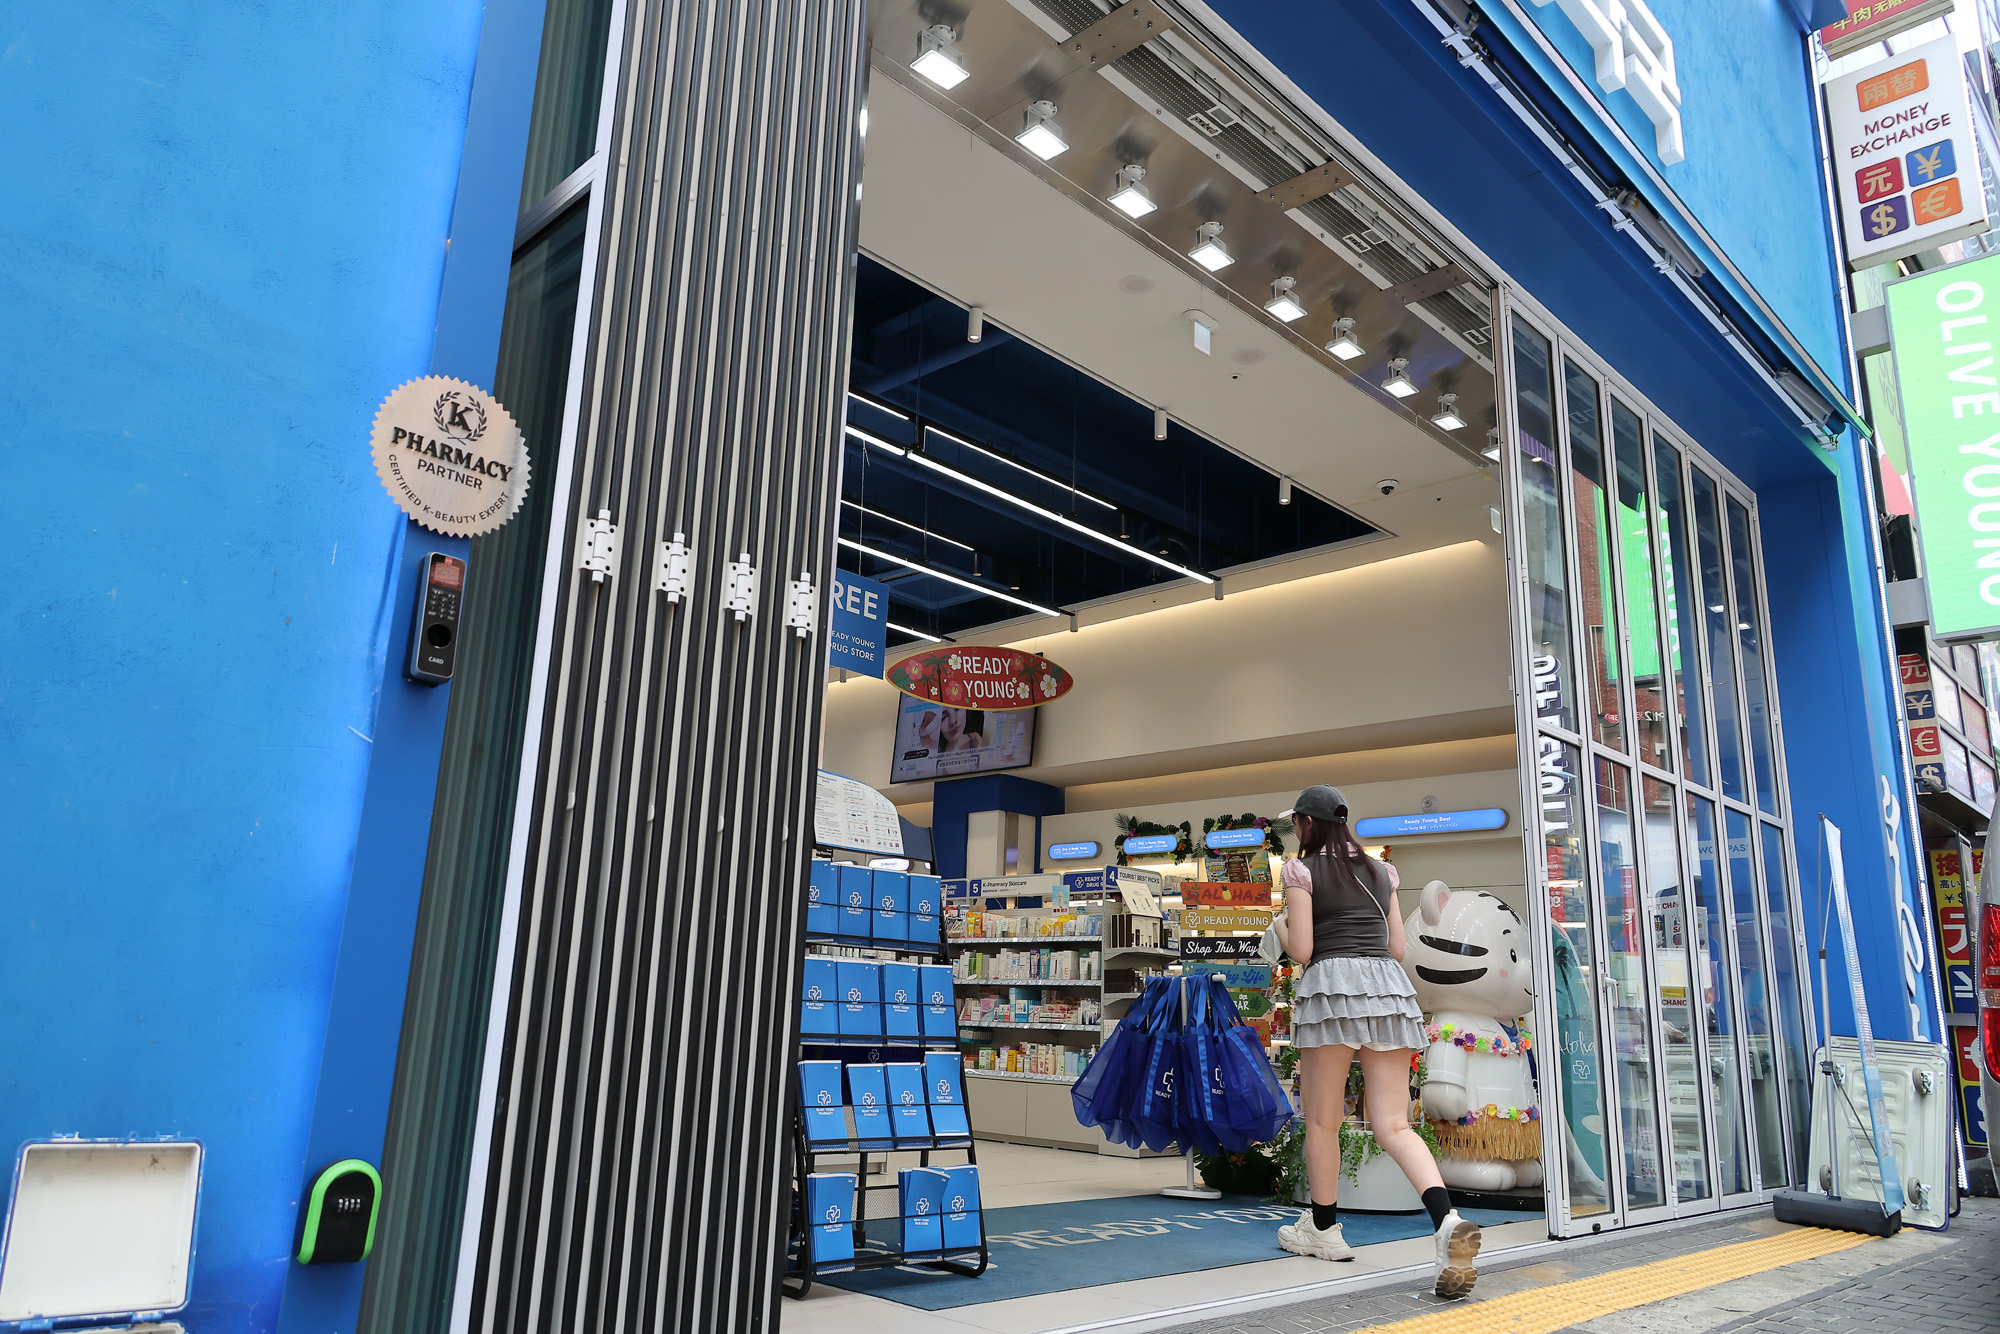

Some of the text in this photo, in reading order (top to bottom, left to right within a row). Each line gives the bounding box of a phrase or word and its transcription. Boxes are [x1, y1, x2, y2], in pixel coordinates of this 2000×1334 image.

[1864, 102, 1930, 136] MONEY
[1851, 113, 1951, 159] EXCHANGE
[1863, 145, 1942, 197] 元 ¥
[1870, 185, 1950, 236] $ €
[1936, 281, 2000, 419] OLIVE
[447, 401, 474, 432] K
[390, 426, 514, 482] PHARMACY
[417, 458, 483, 490] PARTNER
[388, 453, 510, 524] CERTIFIED K-BEAUTY EXPERT
[833, 580, 879, 620] REE
[831, 629, 876, 649] EADY YOUNG
[850, 647, 875, 662] STORE
[962, 656, 1011, 676] READY
[1900, 658, 1928, 680] 元
[963, 679, 1015, 699] YOUNG
[1905, 693, 1933, 716] ¥
[1914, 729, 1938, 753] €
[972, 883, 979, 894] 5
[982, 881, 1008, 889] K-Pharmacy
[1109, 870, 1116, 882] 4
[1119, 871, 1137, 881] TOURIST
[1147, 876, 1160, 885] PICKS
[1204, 915, 1269, 926] READY YOUNG
[1185, 940, 1259, 957] Shop This Way
[1241, 966, 1265, 984] Life
[986, 1204, 1310, 1250] READY YOU
